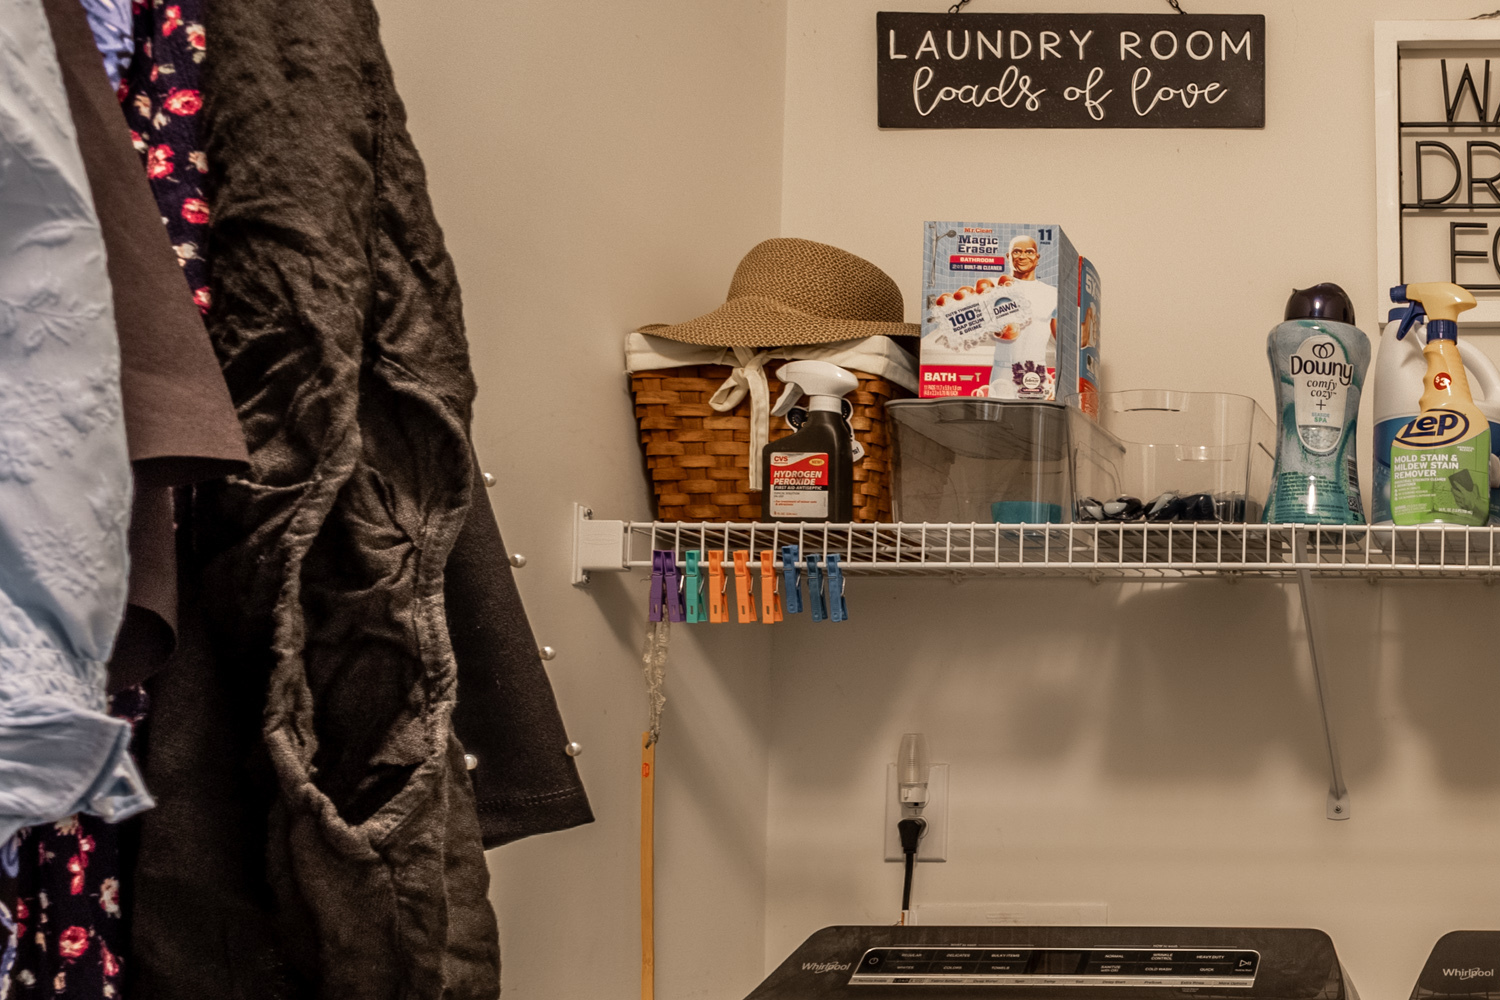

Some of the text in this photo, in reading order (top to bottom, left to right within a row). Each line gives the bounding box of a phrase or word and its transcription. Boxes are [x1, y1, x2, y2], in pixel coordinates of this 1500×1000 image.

[888, 29, 1252, 62] LAUNDRY ROOM
[913, 66, 1228, 121] loads of love
[958, 235, 998, 246] Magic
[1038, 229, 1052, 241] 11
[958, 244, 998, 254] Eraser
[993, 301, 1018, 316] DAWN
[949, 307, 981, 327] 100%
[953, 317, 985, 333] SOAP SCUM
[964, 324, 982, 333] GRIME
[924, 372, 957, 382] BATH
[1290, 355, 1353, 387] Downy
[1306, 379, 1338, 391] comfy
[1394, 454, 1459, 464] MOLD STAIN &
[1394, 461, 1459, 472] MILDEW STAIN
[773, 470, 823, 479] HYDROGEN
[1394, 469, 1437, 479] REMOVER
[773, 478, 816, 486] PEROXIDE
[802, 961, 852, 974] Whirlpool
[1442, 967, 1495, 980] Whirlpool
